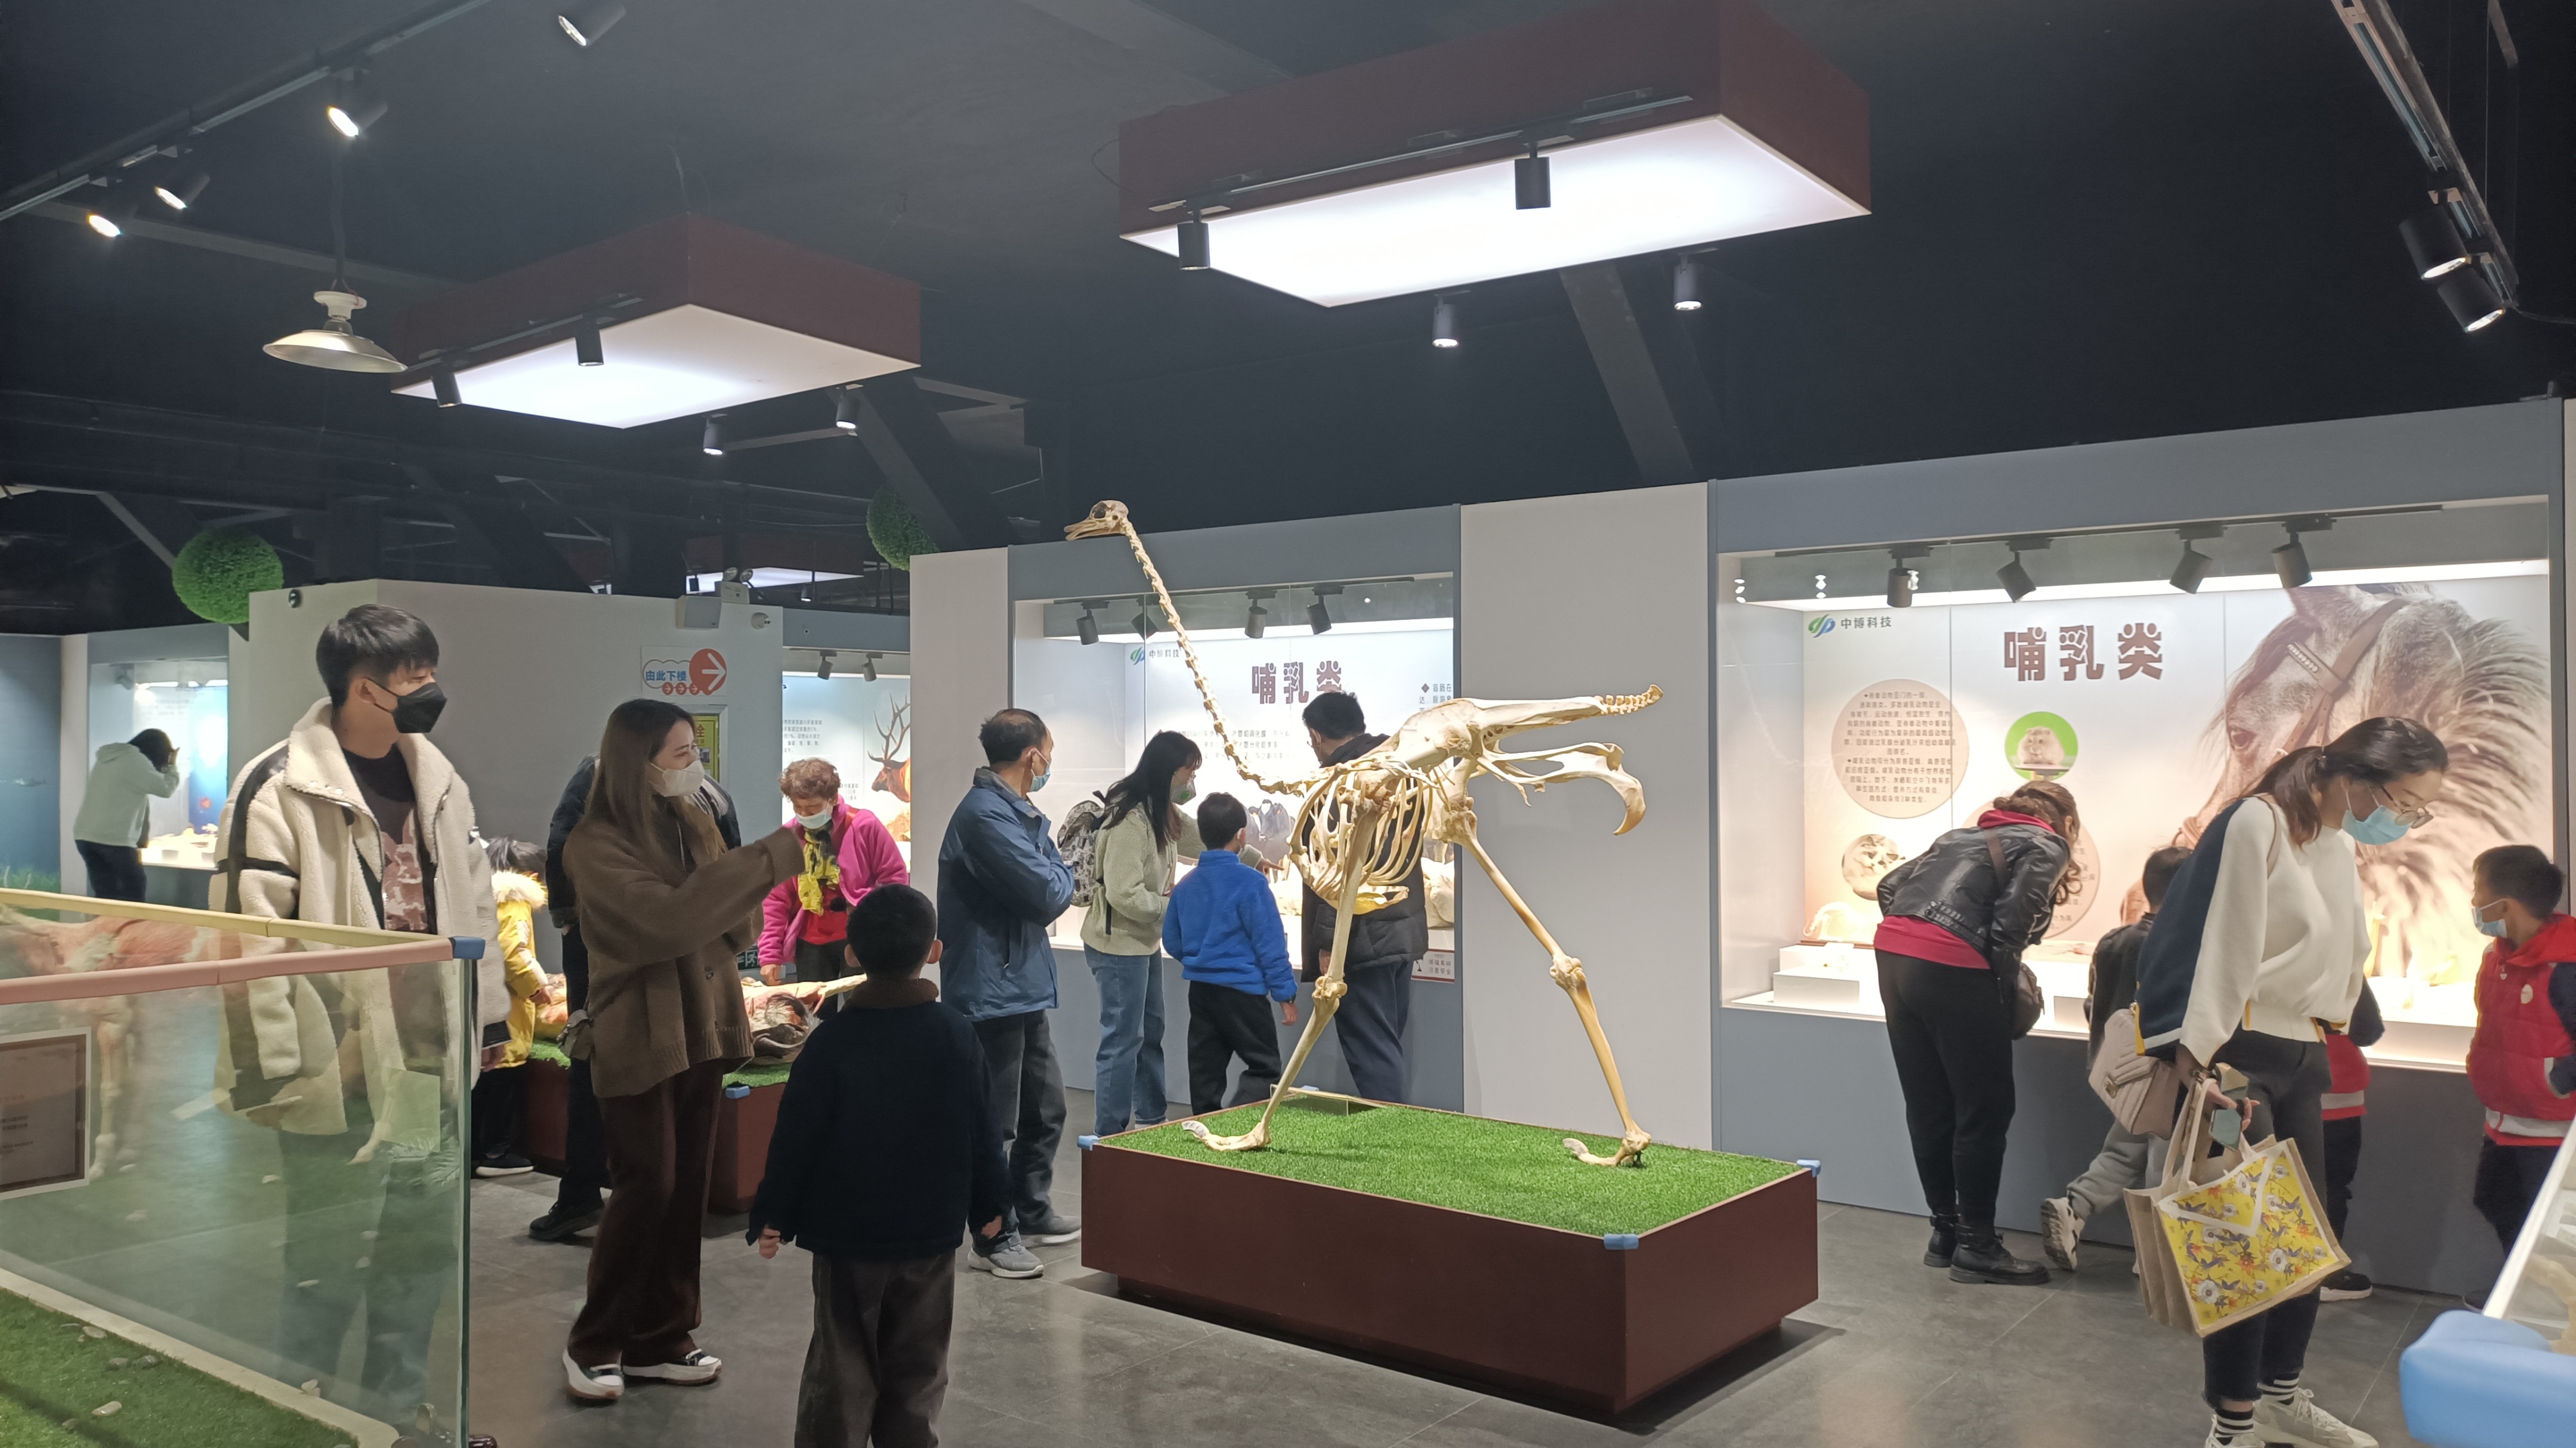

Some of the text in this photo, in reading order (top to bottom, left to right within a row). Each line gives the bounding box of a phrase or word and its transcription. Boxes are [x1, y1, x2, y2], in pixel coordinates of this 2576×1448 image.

[1840, 616, 1892, 629] 中博科技
[2004, 622, 2163, 681] 哺乳类
[645, 670, 687, 681] 由此下楼
[1252, 660, 1342, 705] 哺乳类
